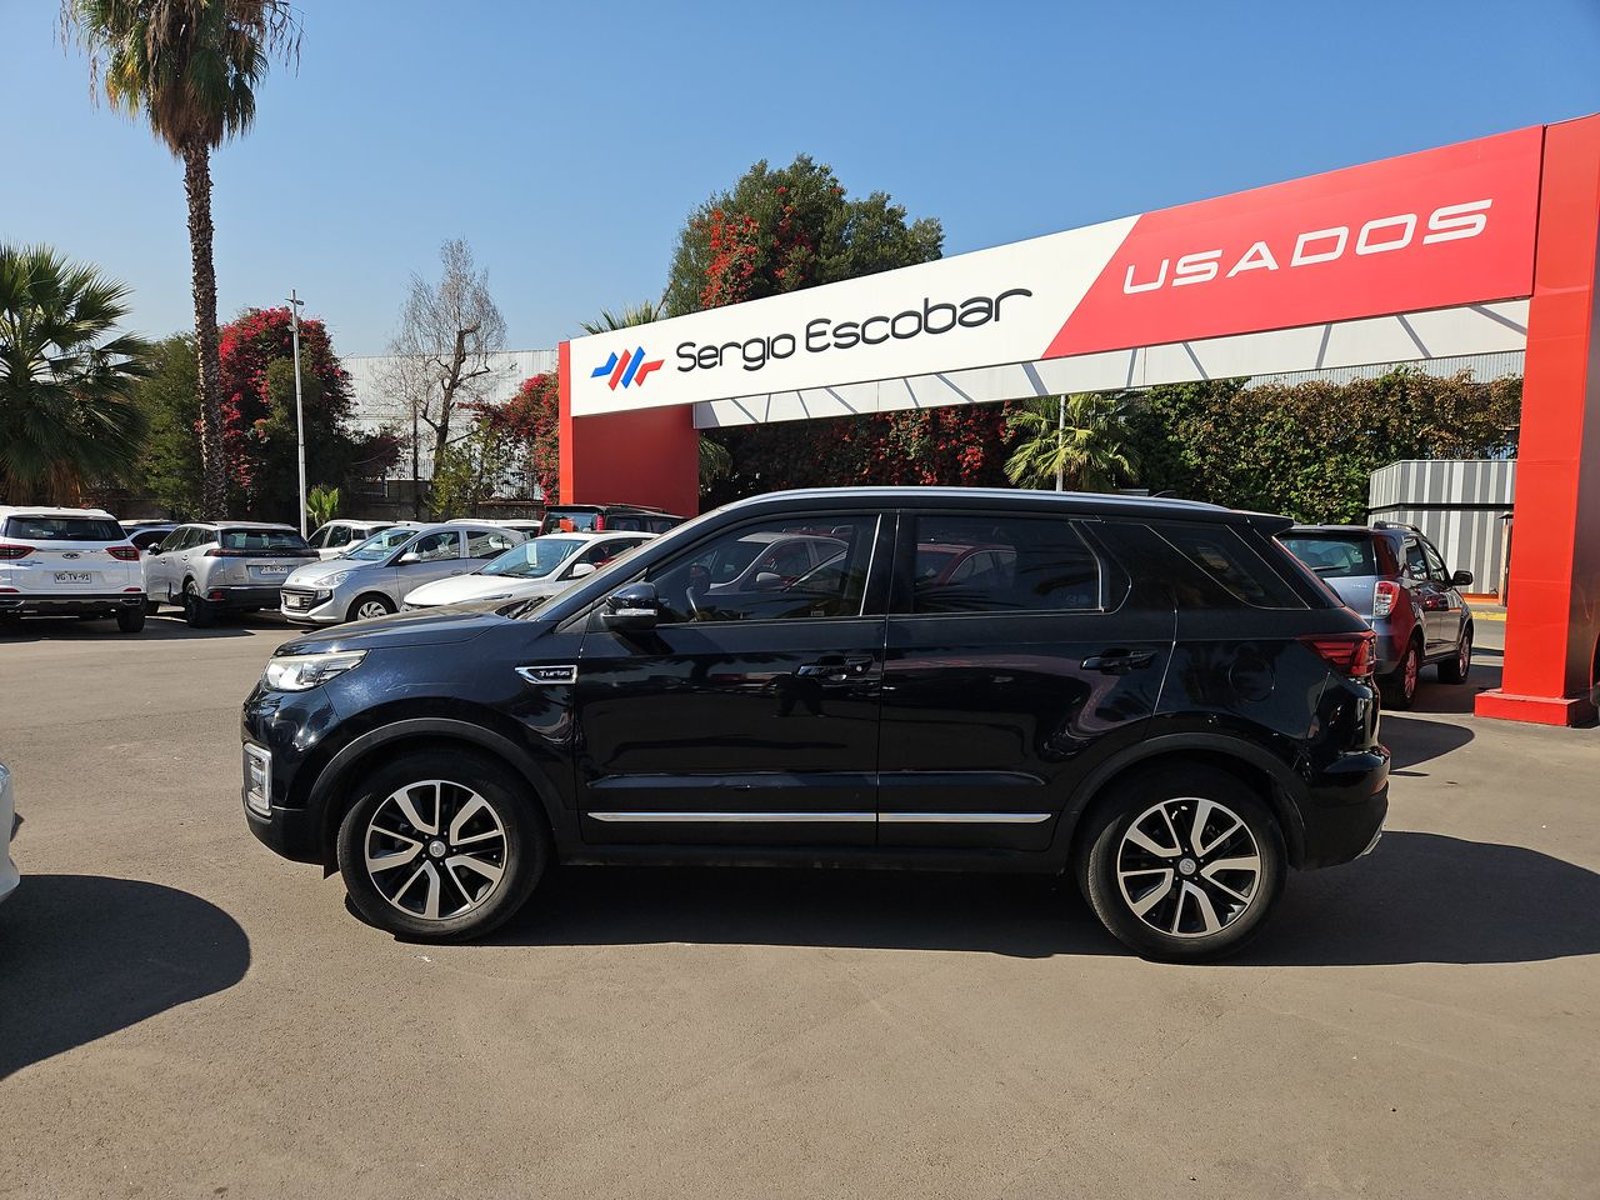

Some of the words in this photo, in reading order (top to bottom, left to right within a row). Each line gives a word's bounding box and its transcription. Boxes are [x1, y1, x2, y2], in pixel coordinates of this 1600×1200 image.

[1123, 199, 1493, 295] USADOS
[676, 333, 795, 372] Sergio
[805, 288, 1033, 353] Escobar
